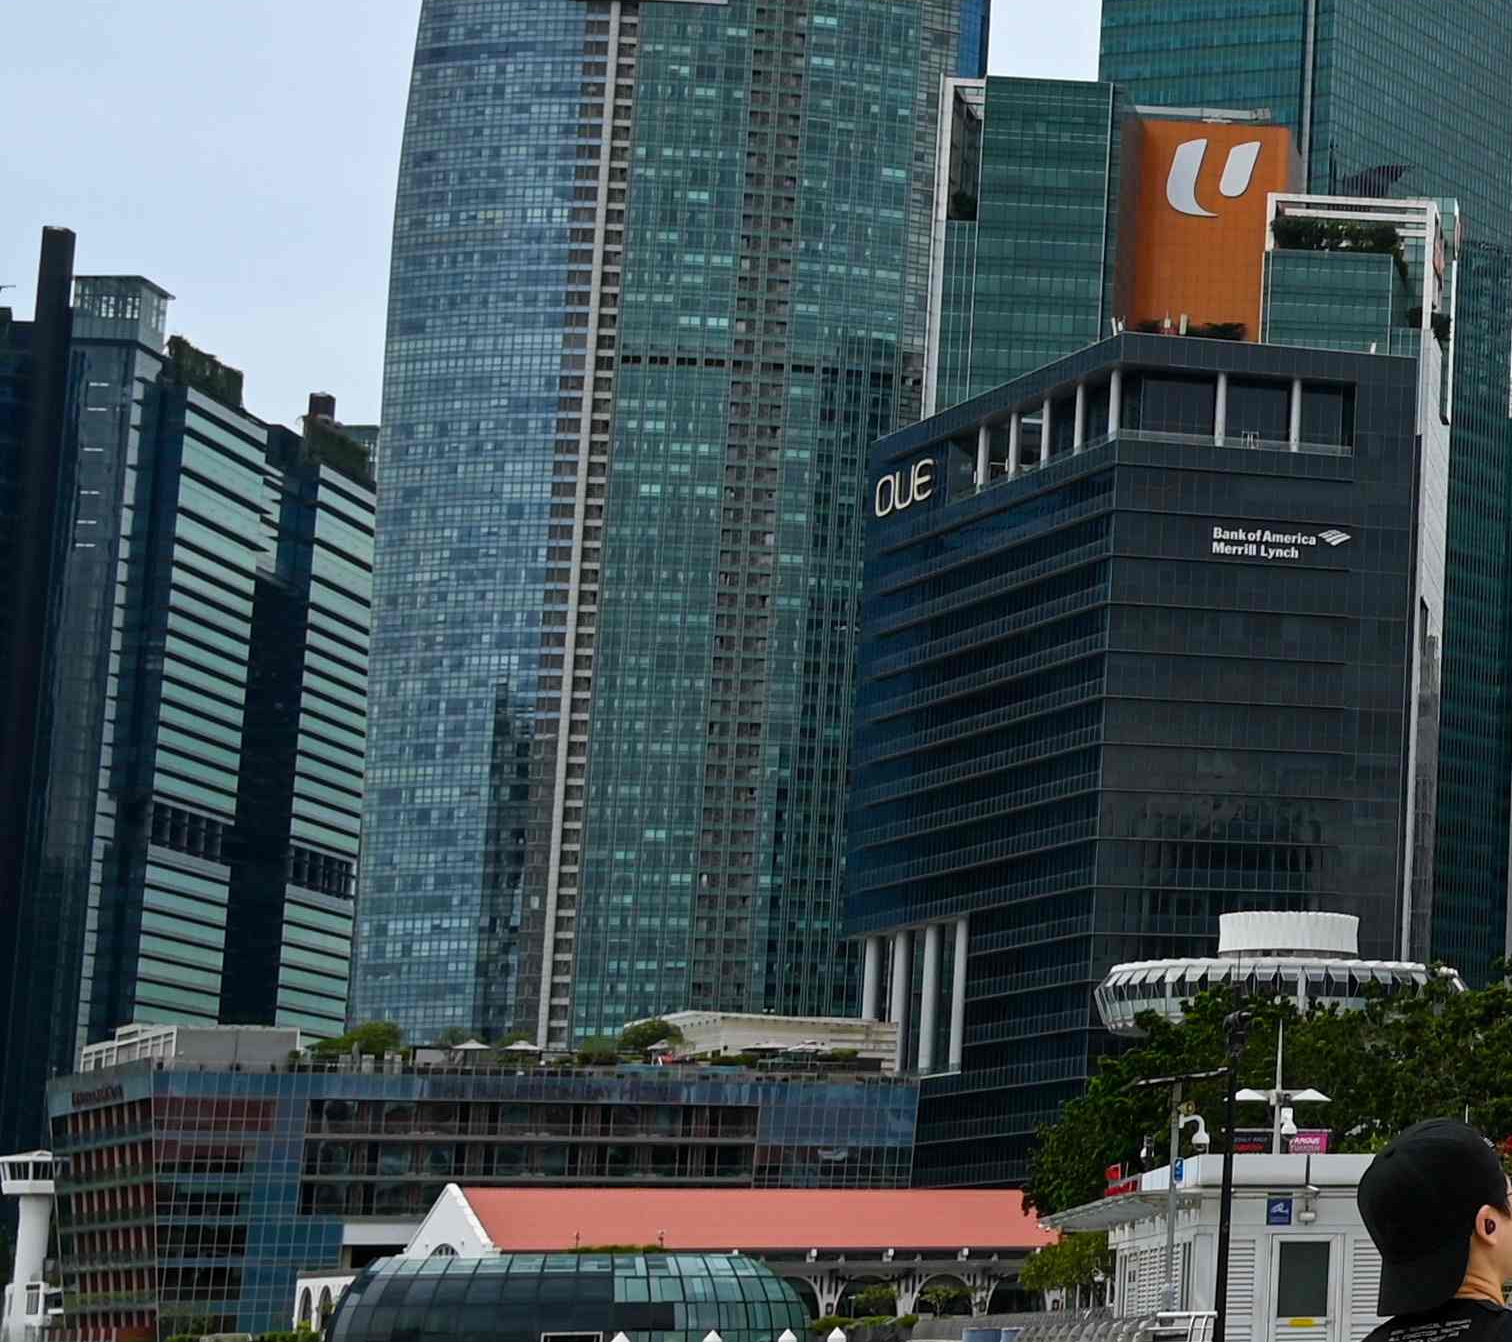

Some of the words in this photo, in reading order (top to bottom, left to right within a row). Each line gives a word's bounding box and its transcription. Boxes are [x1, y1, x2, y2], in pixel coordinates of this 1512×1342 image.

[875, 458, 935, 518] OUE
[1212, 526, 1247, 541] Bank
[1247, 529, 1262, 542] of
[1262, 530, 1317, 546] America
[1211, 541, 1257, 556] Merrill
[1260, 544, 1300, 560] Lynch
